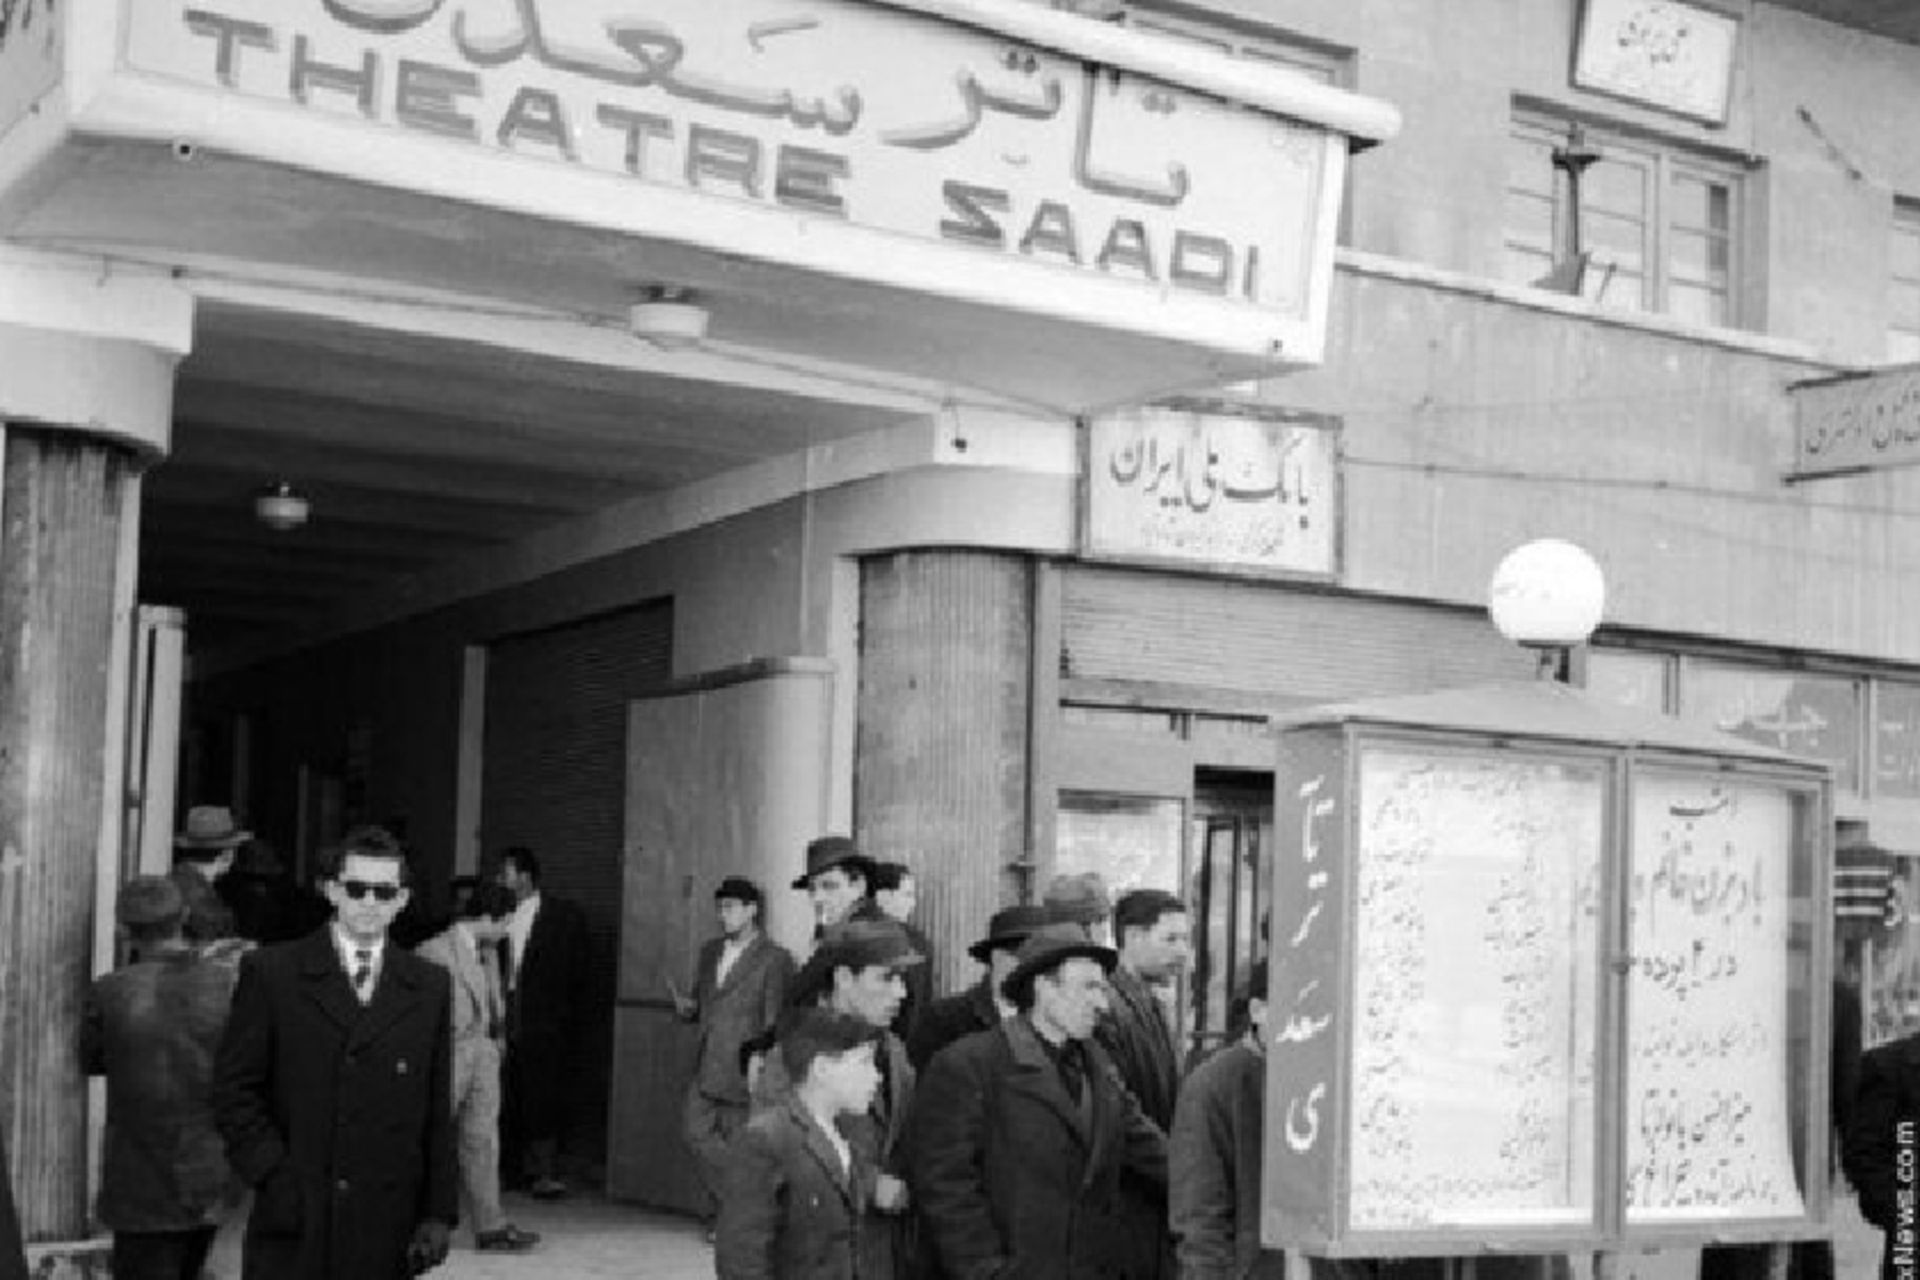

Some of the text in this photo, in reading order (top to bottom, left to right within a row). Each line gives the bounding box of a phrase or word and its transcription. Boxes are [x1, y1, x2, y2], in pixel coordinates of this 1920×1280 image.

[183, 7, 1259, 302] THEATRE SAADI
[1108, 436, 1184, 508] ایران
